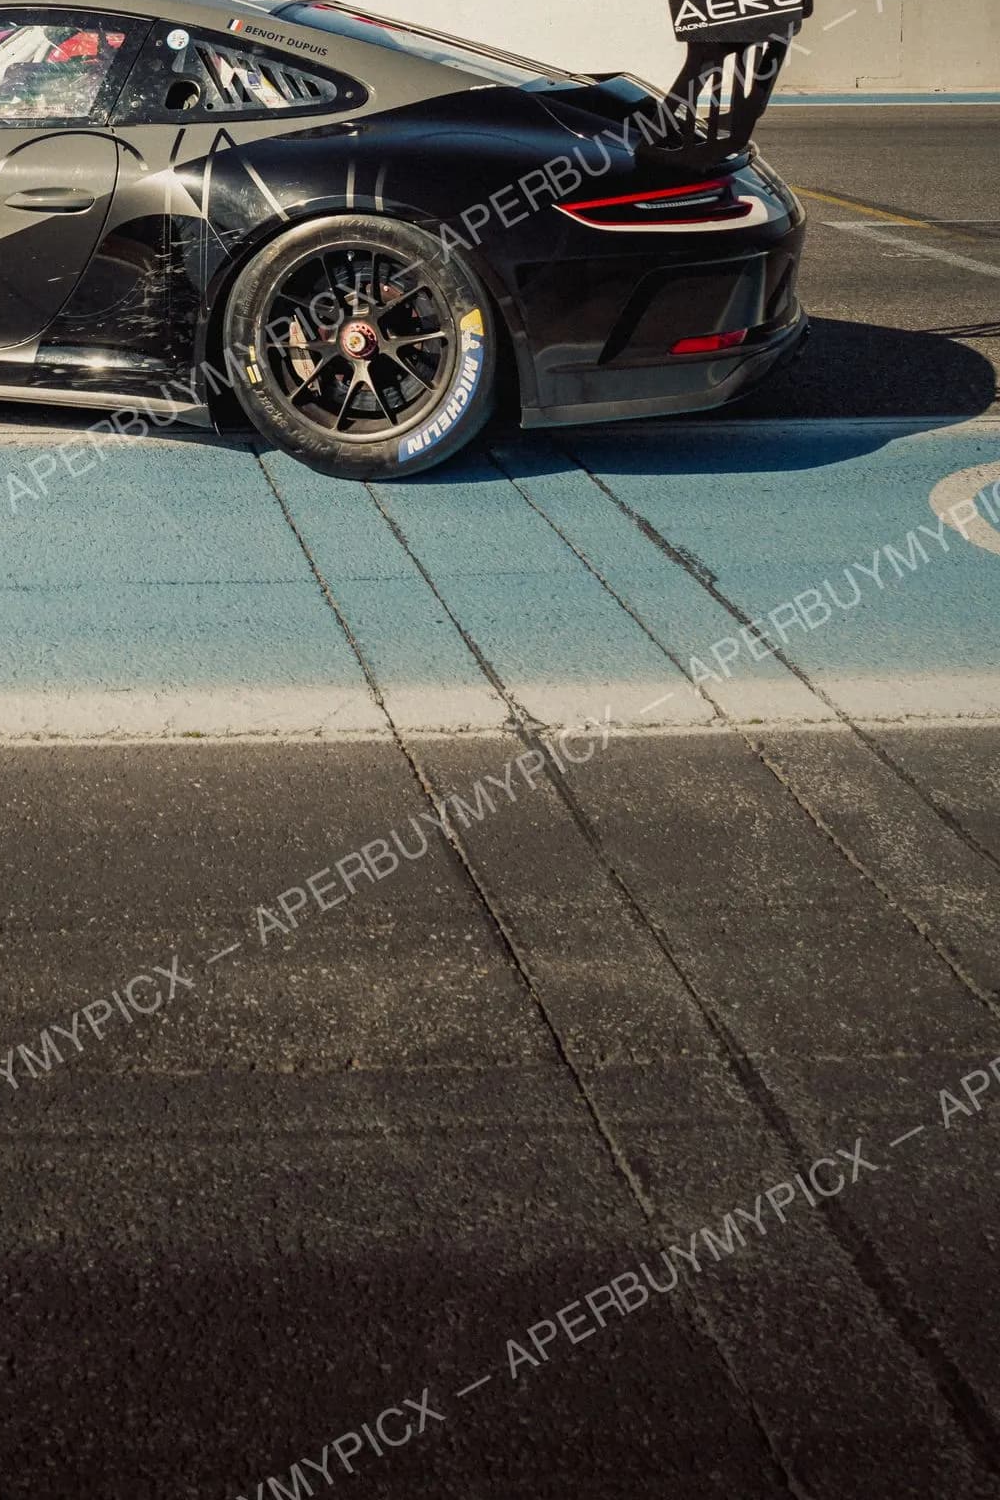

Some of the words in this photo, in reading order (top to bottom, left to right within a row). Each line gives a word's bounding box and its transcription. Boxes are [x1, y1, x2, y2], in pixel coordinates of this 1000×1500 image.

[244, 24, 286, 44] BENOIT
[286, 37, 329, 56] DUPUIS
[675, 21, 709, 33] RACING
[406, 355, 480, 455] MICHELIN
